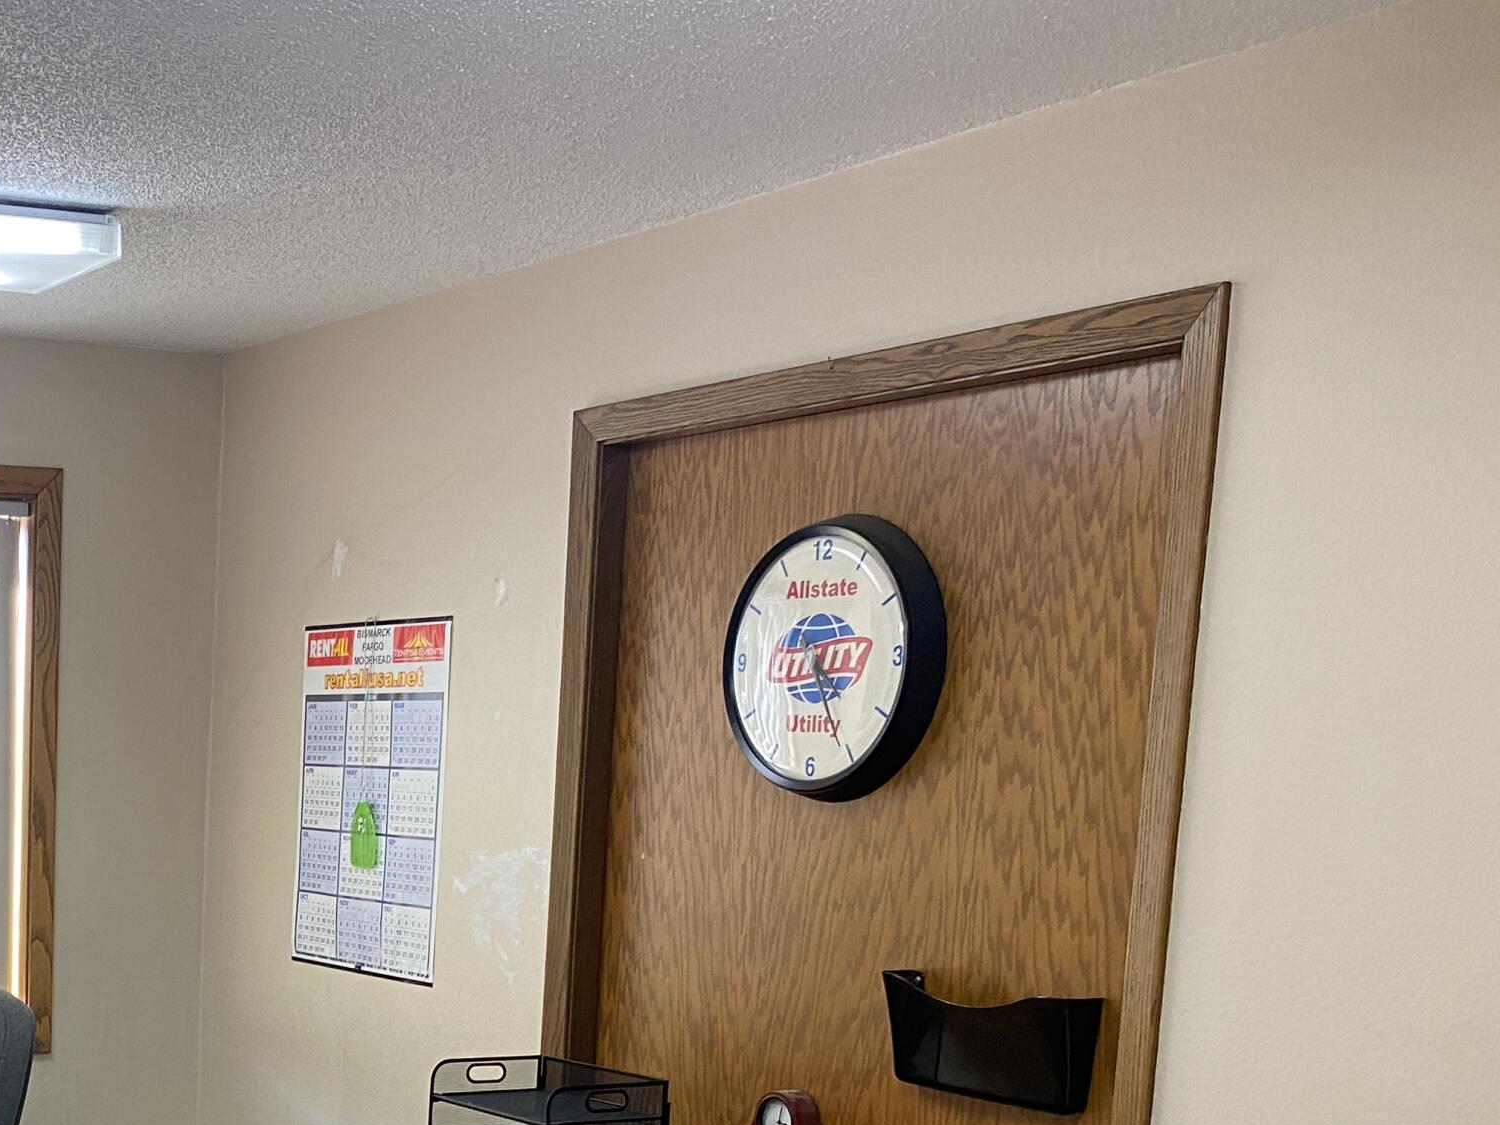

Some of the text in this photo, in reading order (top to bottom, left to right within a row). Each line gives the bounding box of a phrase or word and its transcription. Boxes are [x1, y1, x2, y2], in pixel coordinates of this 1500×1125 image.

[813, 539, 833, 561] 12
[786, 578, 859, 600] Allstate
[357, 628, 391, 639] BISMARCK
[362, 641, 384, 652] FARGO
[893, 645, 903, 667] 3
[354, 655, 391, 666] MOORHEAD
[738, 653, 746, 673] 9
[773, 641, 867, 679] UTIITY
[786, 713, 841, 738] Utility
[805, 756, 815, 777] 6
